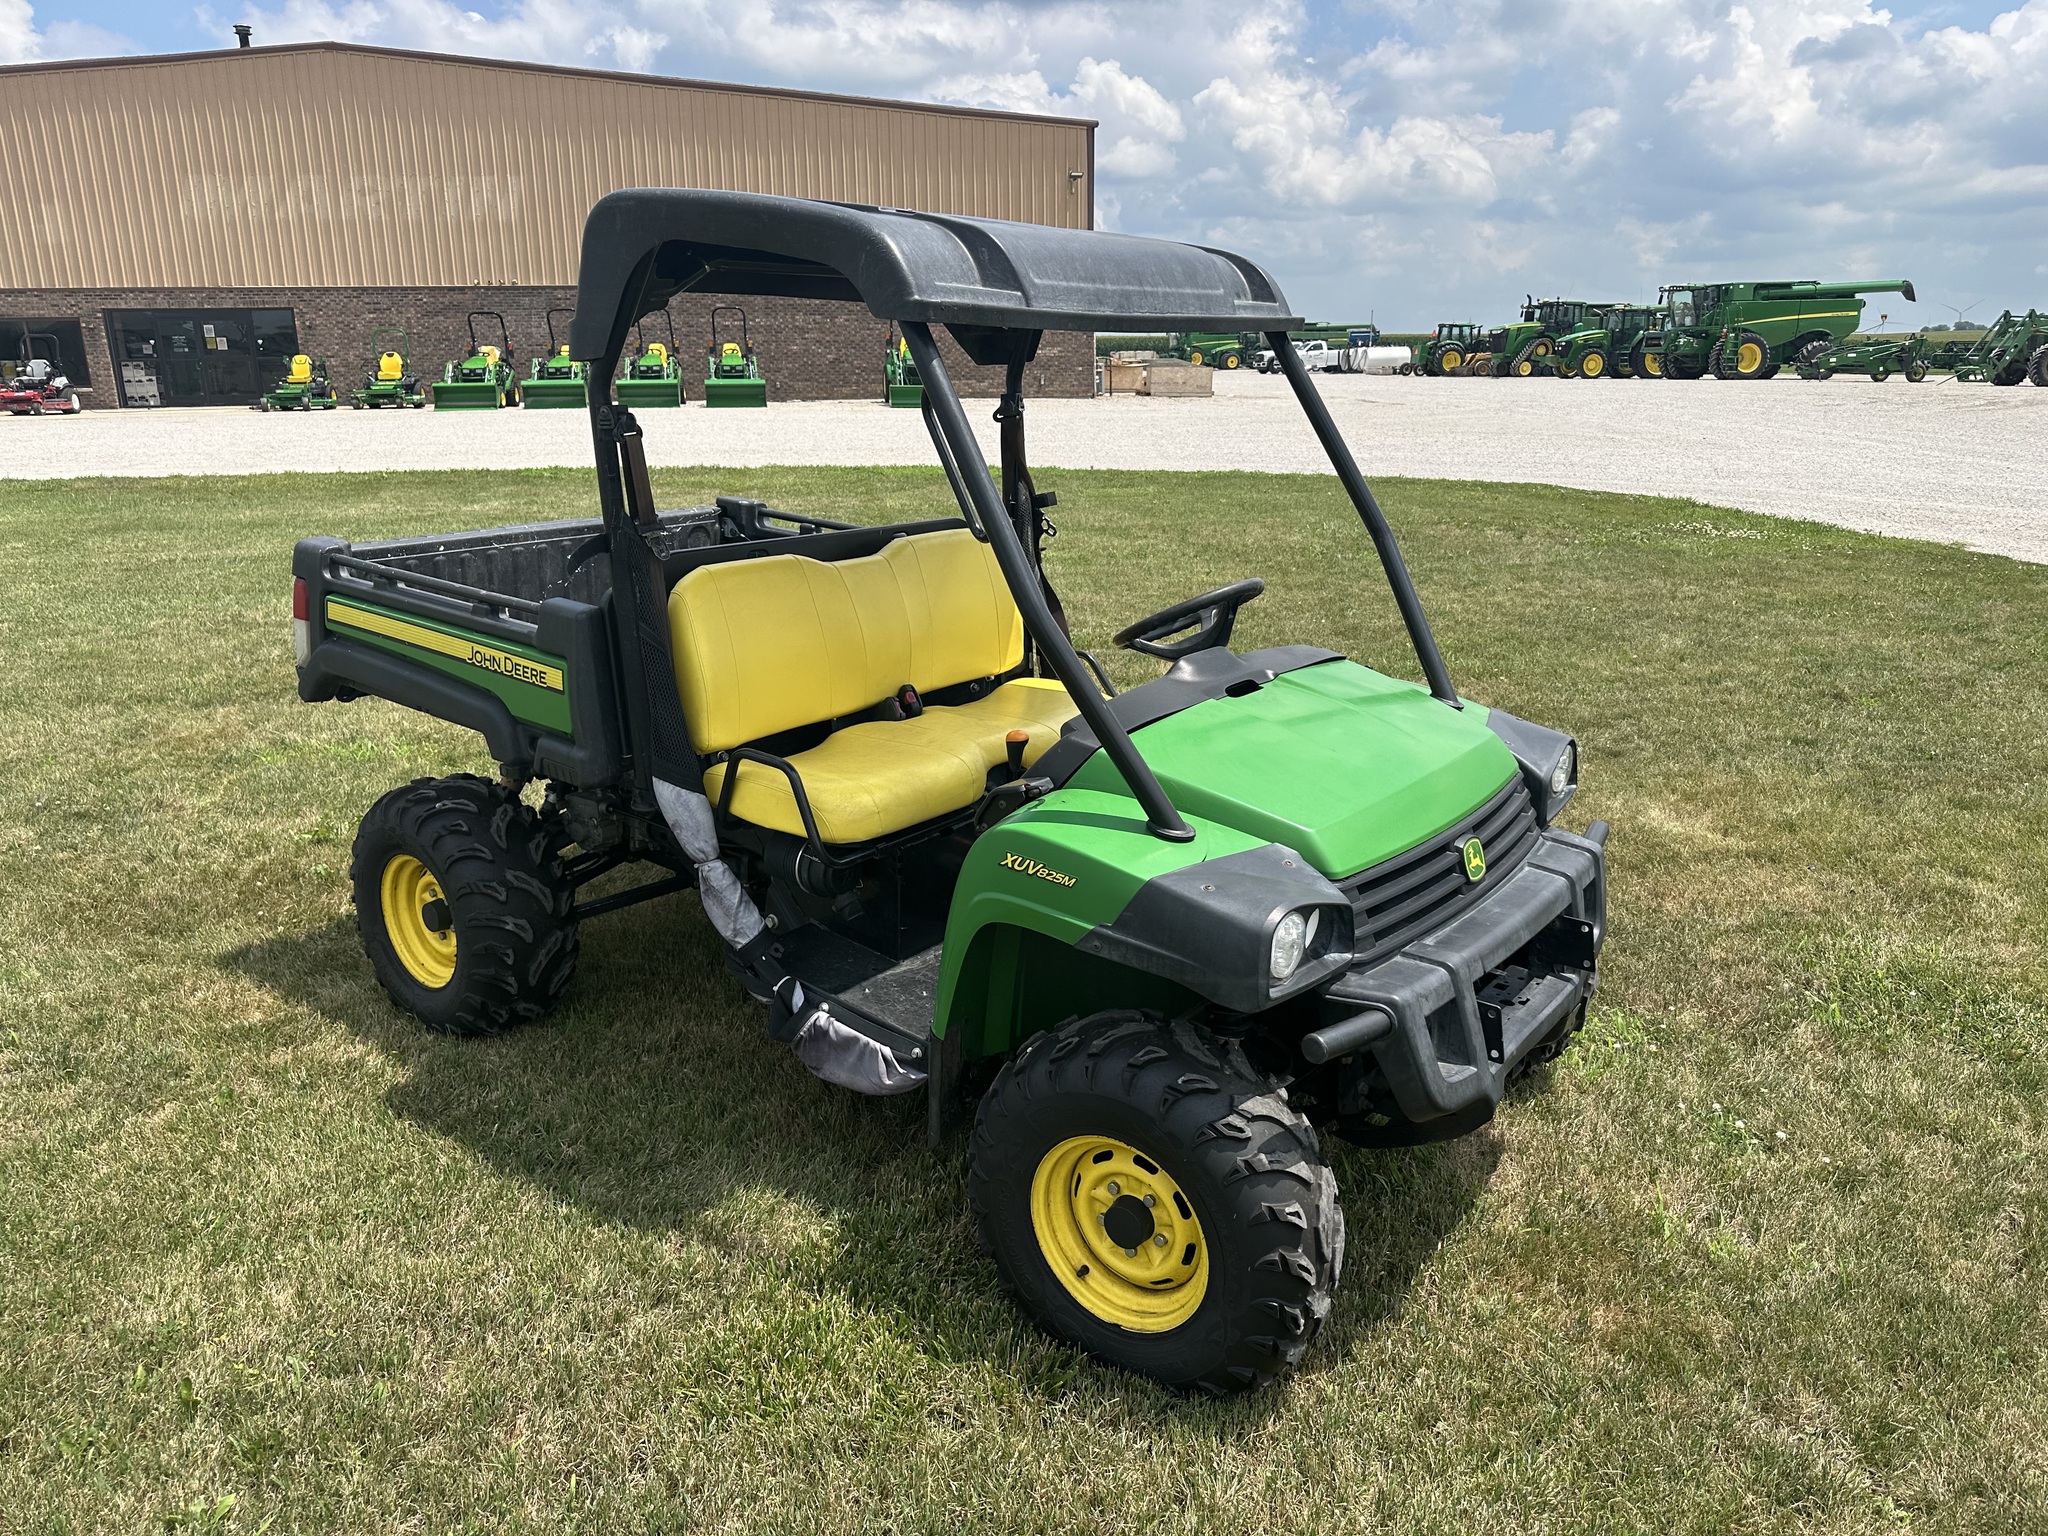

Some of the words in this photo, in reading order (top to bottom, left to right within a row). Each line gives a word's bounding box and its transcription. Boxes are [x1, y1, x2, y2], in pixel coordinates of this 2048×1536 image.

[467, 646, 501, 671] JOHN
[504, 656, 547, 685] DEERE
[1000, 851, 1078, 888] XUV825M
